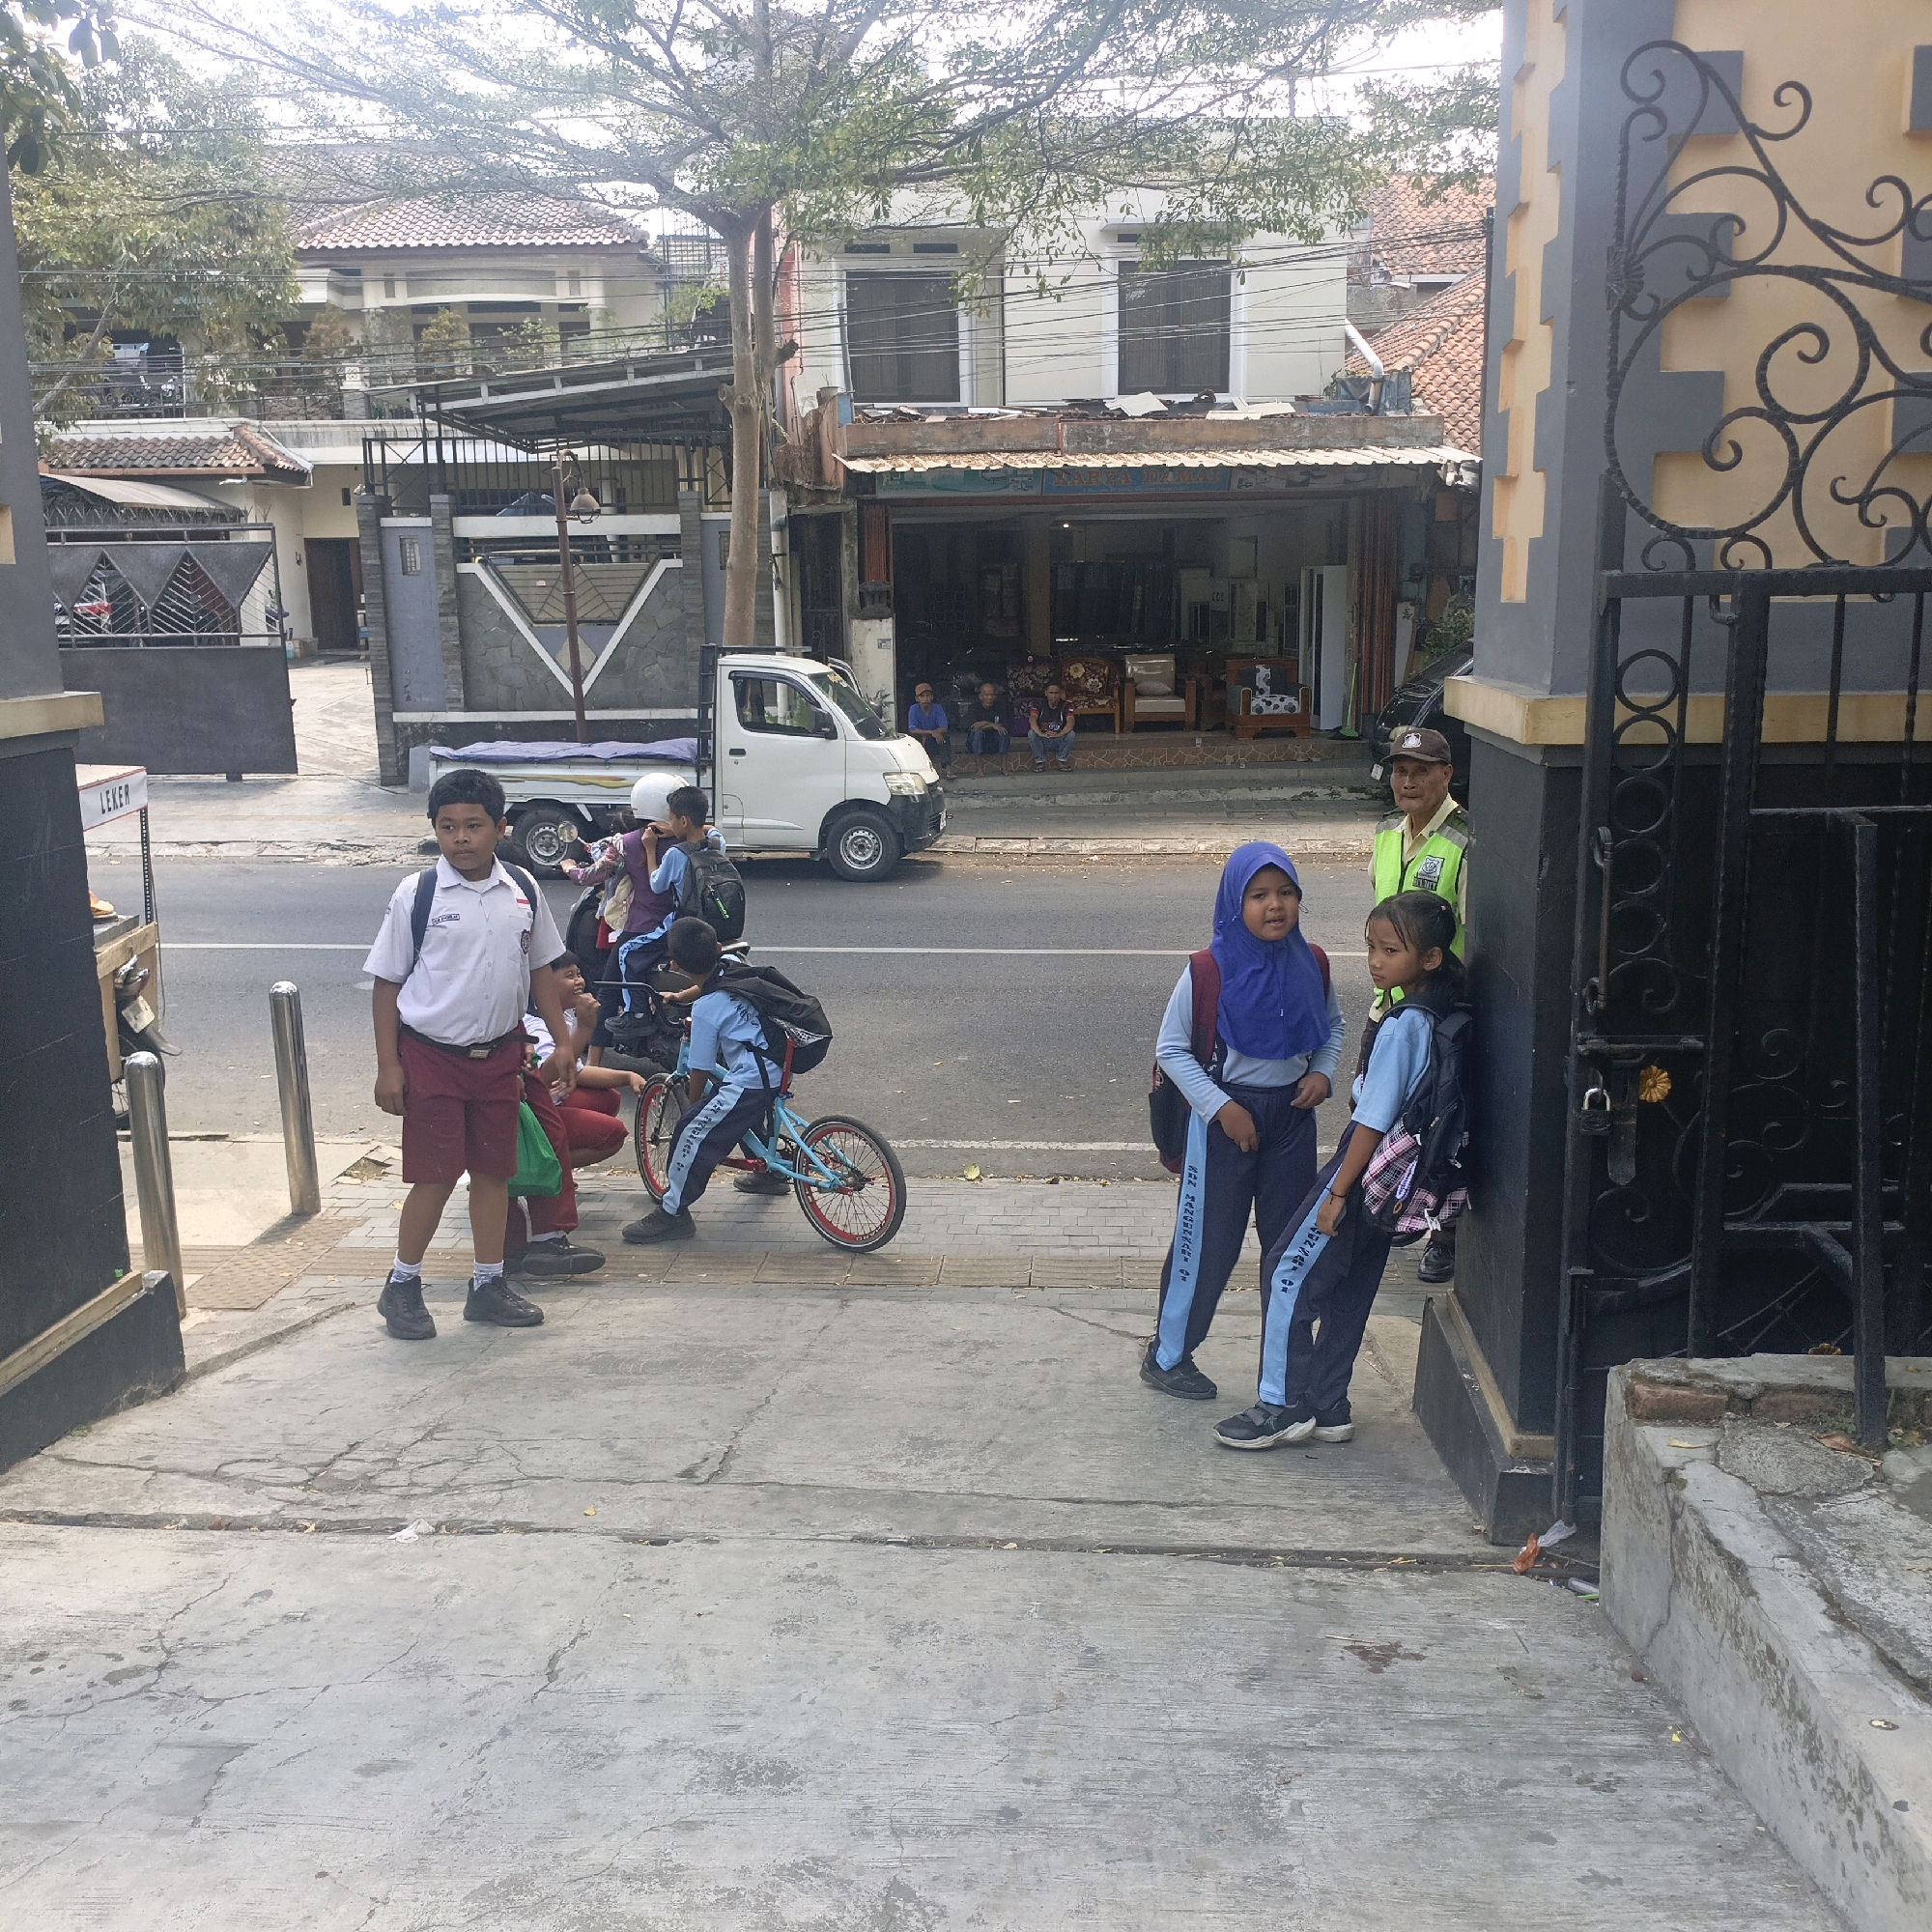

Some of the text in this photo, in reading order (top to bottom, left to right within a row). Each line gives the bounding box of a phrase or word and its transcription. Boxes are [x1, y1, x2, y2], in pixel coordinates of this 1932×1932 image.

[1054, 468, 1221, 486] KARYA DAMAI
[99, 783, 130, 814] LEKER
[1187, 1165, 1199, 1188] SDN
